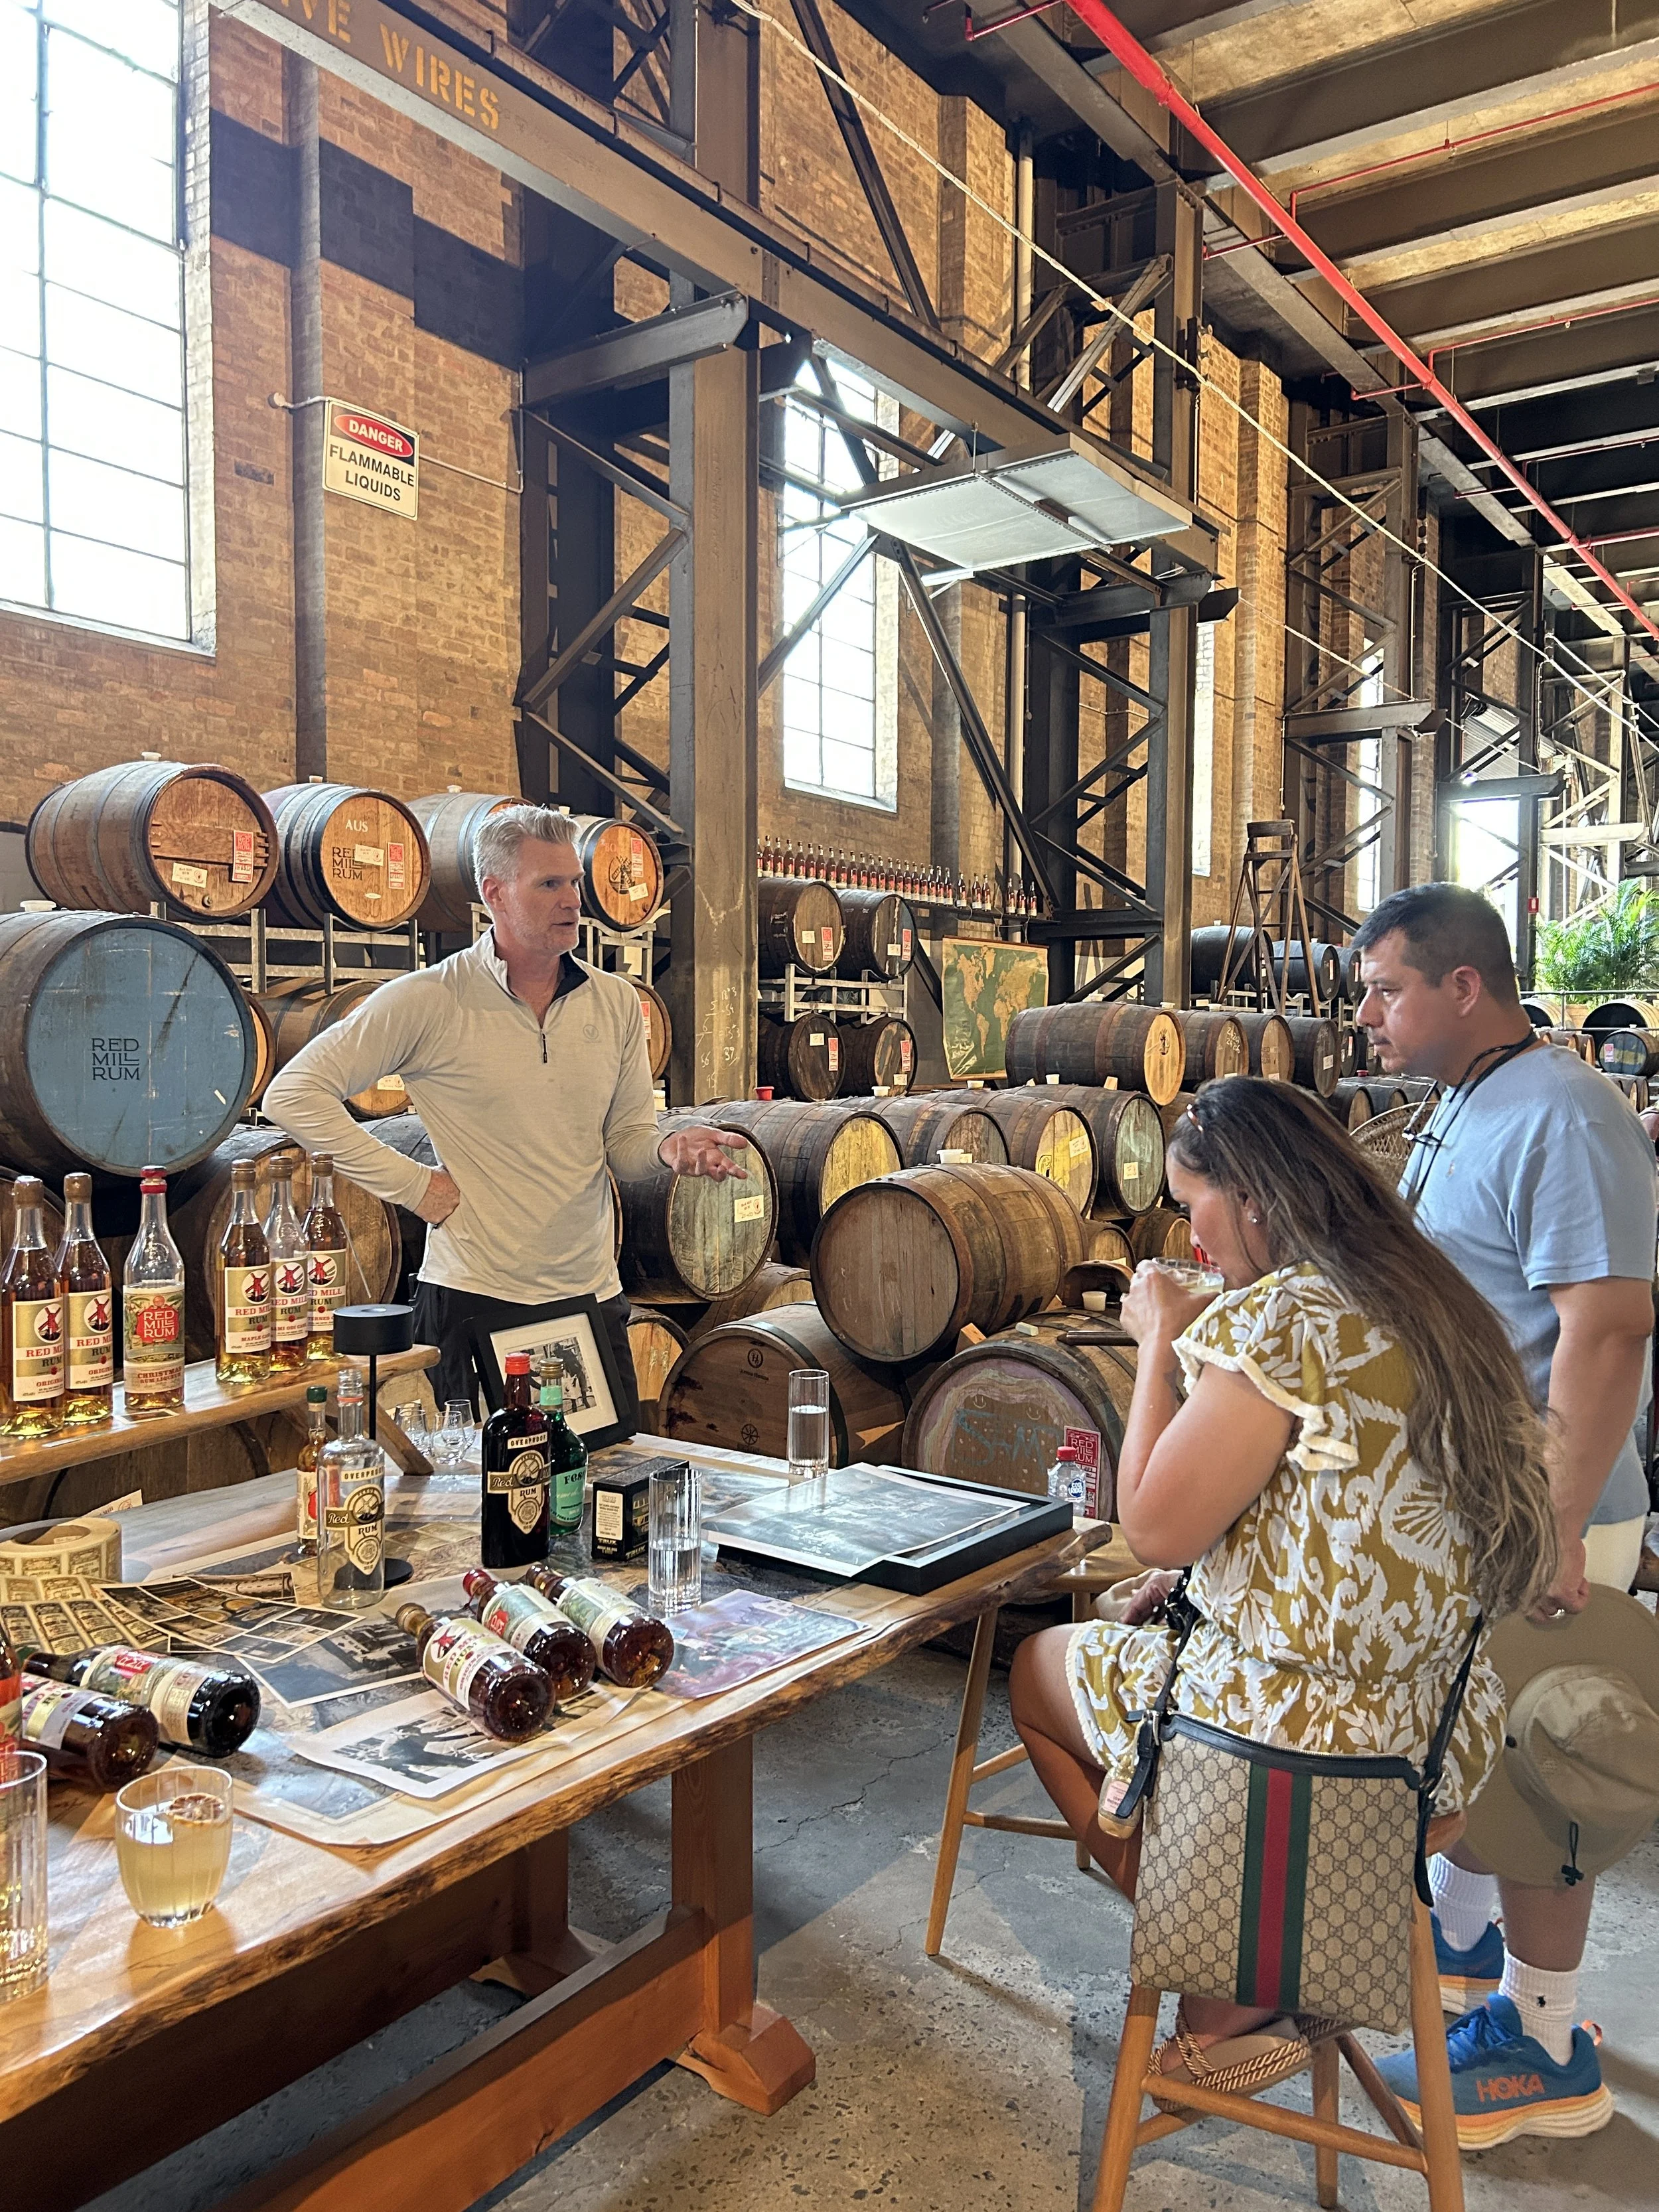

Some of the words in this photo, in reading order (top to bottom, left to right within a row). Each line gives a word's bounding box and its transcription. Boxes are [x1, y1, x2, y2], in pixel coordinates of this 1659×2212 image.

[380, 22, 498, 129] WIRES
[349, 419, 403, 453] DANGER
[329, 444, 414, 487] FLAMMABLE
[345, 470, 401, 501] LIQUIDS
[345, 819, 368, 832] AUS
[332, 867, 362, 881] RUM
[92, 1038, 139, 1051] RED
[92, 1053, 139, 1066] MILL
[92, 1067, 139, 1080] RUM
[143, 1311, 175, 1321] RED
[249, 1315, 267, 1325] RUM
[143, 1320, 175, 1329] MILL
[143, 1328, 175, 1338] RUM
[76, 1338, 100, 1347] RED
[26, 1348, 50, 1357] RED
[92, 1346, 111, 1356] RUM
[42, 1357, 62, 1367] RUM
[137, 1366, 182, 1378] CHRISTMAS
[511, 1434, 546, 1447] OVERPROOF
[1070, 1438, 1094, 1449] RED
[1076, 1453, 1094, 1464] UM
[492, 1477, 514, 1487] Red
[520, 1488, 537, 1497] RUM
[328, 1512, 350, 1524] Red
[358, 1524, 377, 1536] RUM
[1476, 2073, 1546, 2103] HOKA
